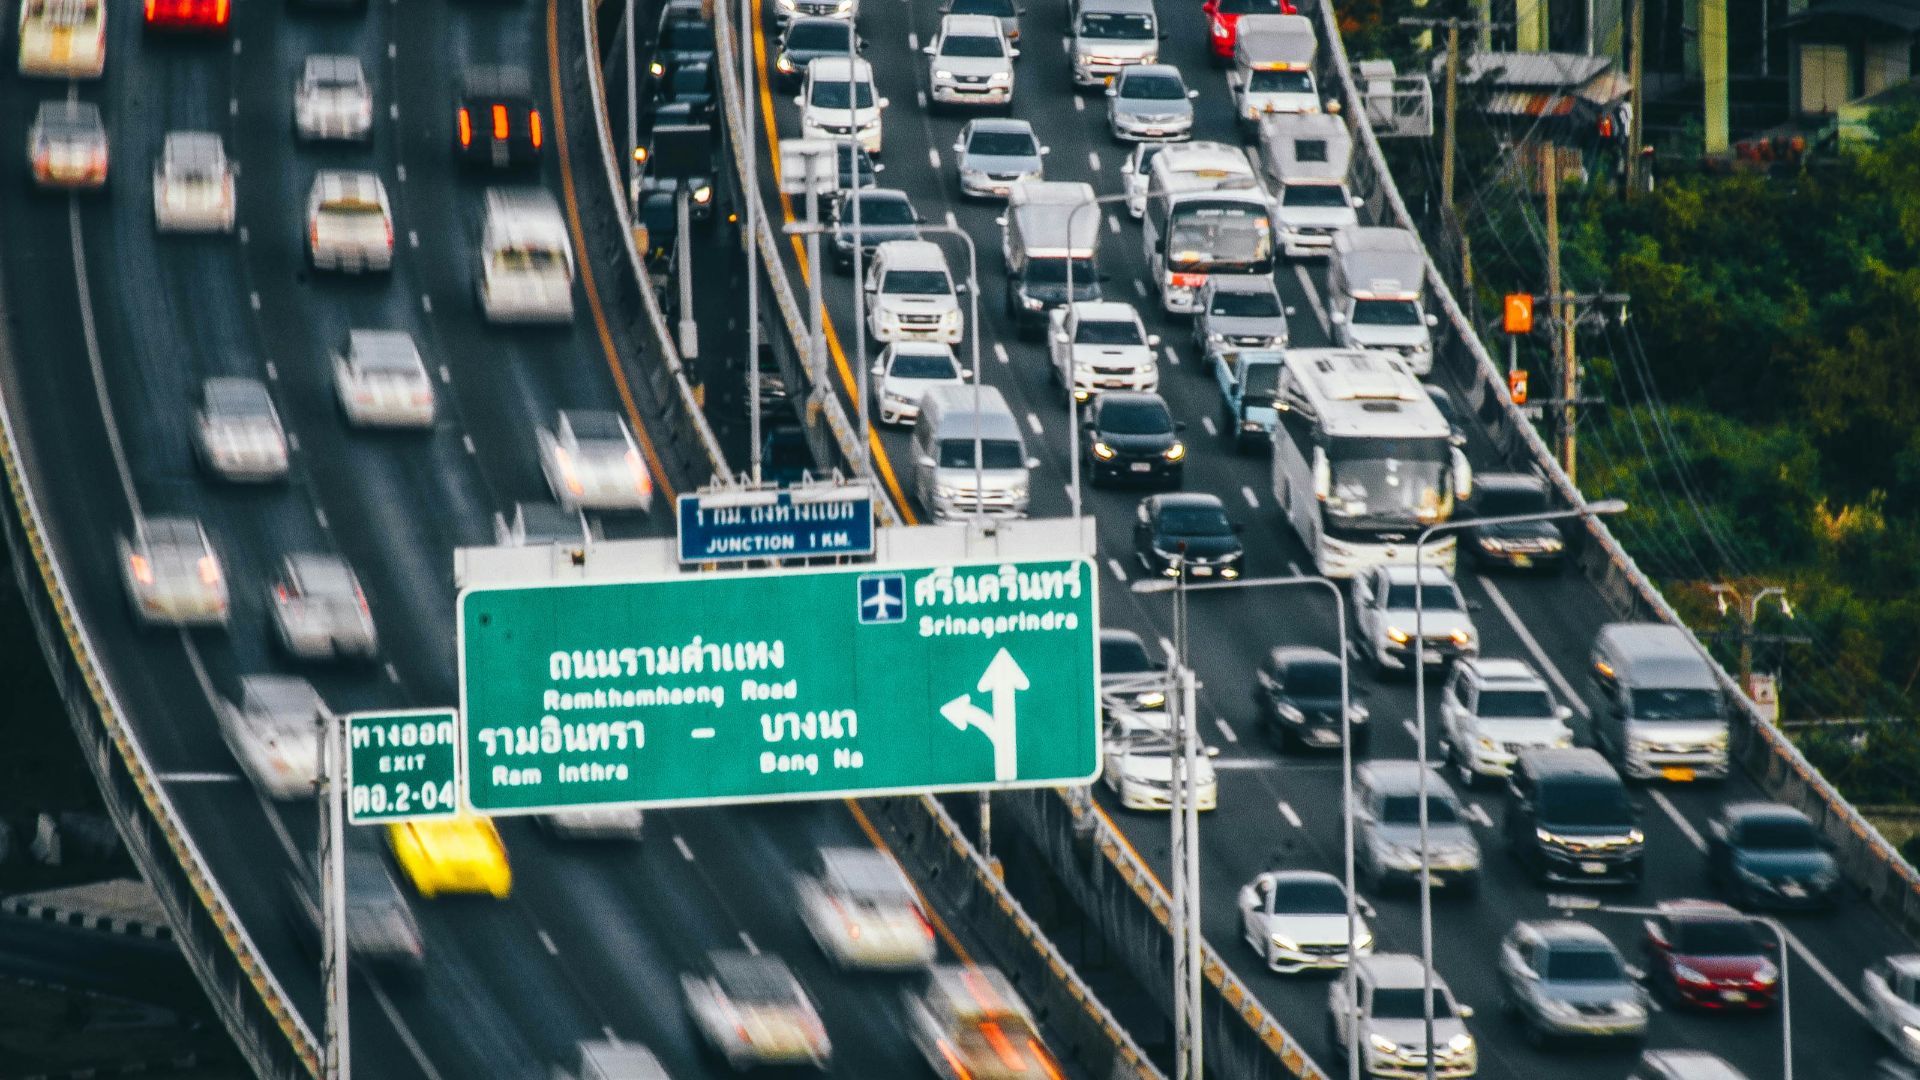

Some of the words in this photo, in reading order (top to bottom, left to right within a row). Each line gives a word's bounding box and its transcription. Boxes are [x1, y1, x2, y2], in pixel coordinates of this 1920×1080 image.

[706, 534, 795, 554] JUNCTION
[810, 532, 816, 547] 1
[914, 560, 1082, 606] ศรีนครินทร์
[919, 611, 1078, 639] Srinagarindra
[549, 635, 785, 680] ถนนรามคำแหง
[543, 685, 724, 709] Ramkhamhaeng
[741, 680, 798, 701] Road
[352, 722, 454, 749] ทางออก
[478, 715, 645, 757] รามอินทรา
[760, 709, 858, 742] บางนา
[379, 753, 426, 773] EXIT
[492, 765, 542, 786] Ram
[558, 763, 629, 783] Inthra
[759, 752, 819, 775] Bang
[833, 748, 864, 769] Na
